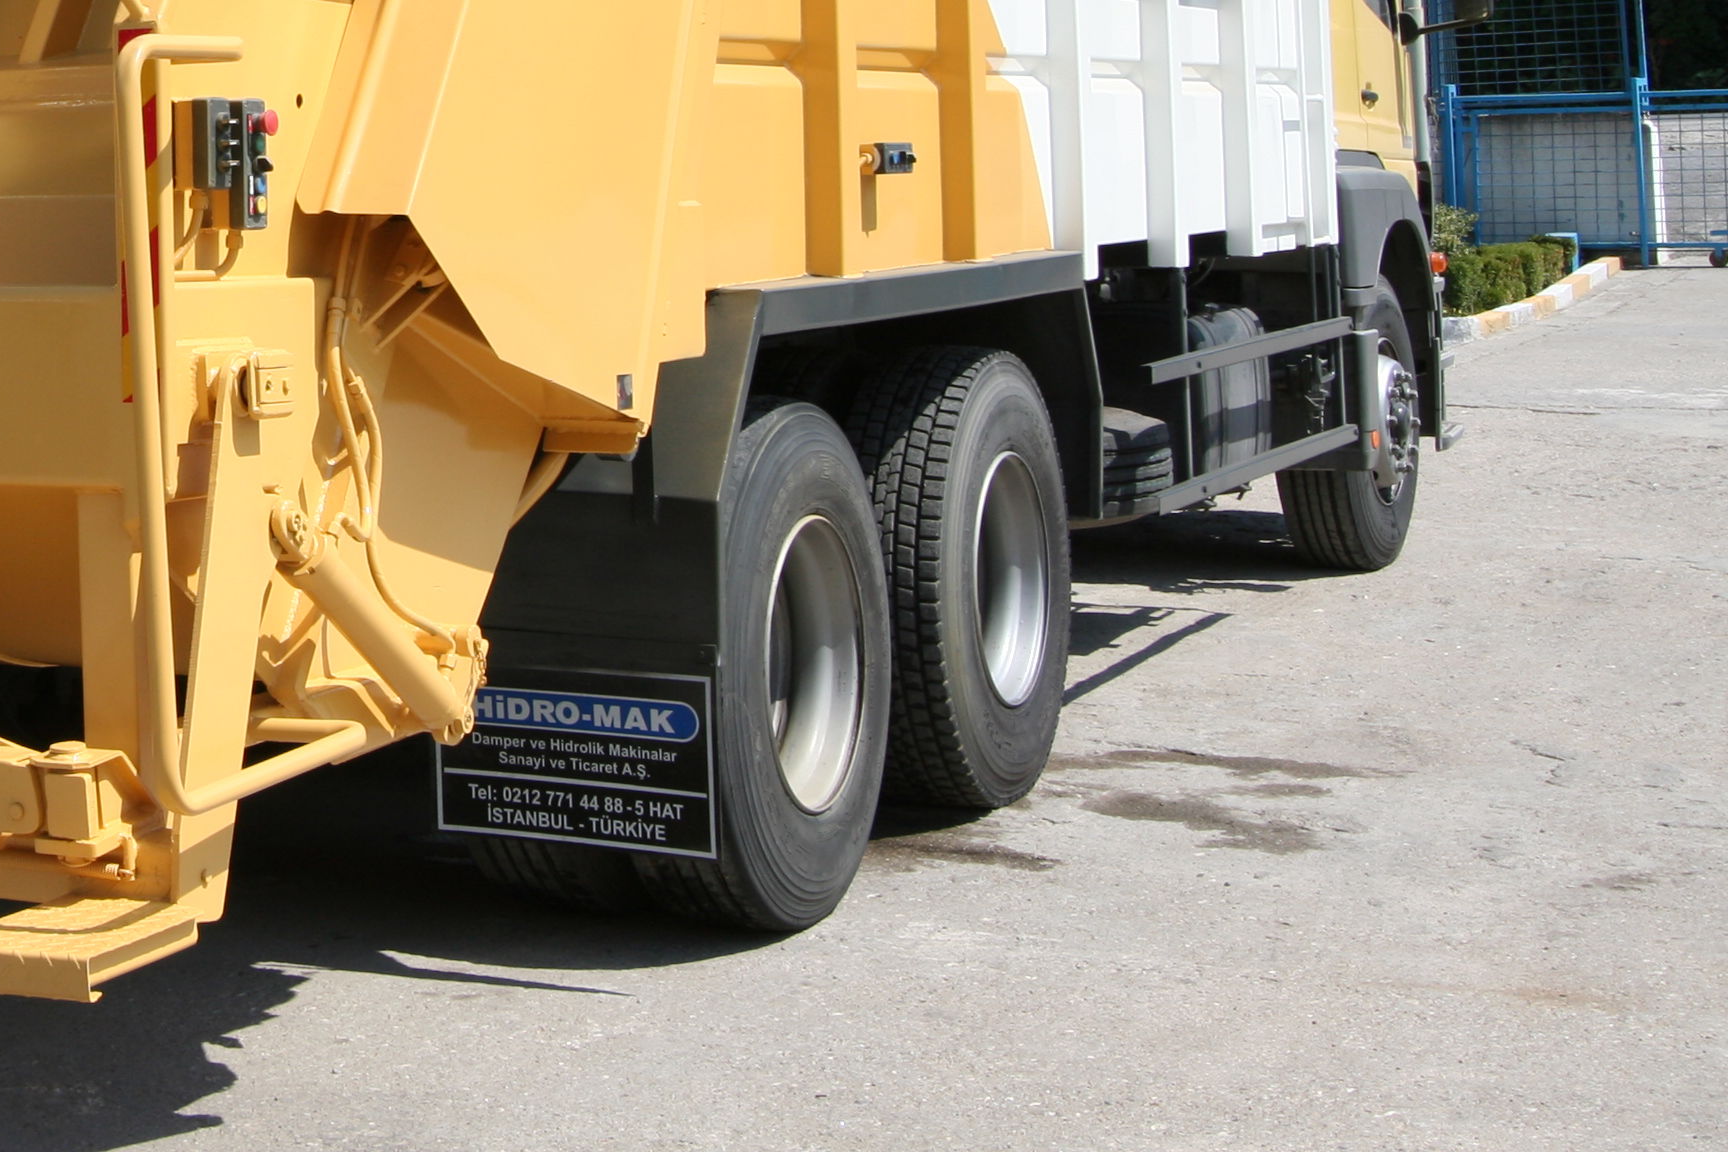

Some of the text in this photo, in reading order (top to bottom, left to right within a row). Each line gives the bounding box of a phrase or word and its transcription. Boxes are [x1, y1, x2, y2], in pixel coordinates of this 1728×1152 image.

[472, 732, 677, 762] Damper ve Hidrolik Makinalar
[498, 751, 651, 780] Sanayi ve Ticaret A.Ş.
[468, 783, 497, 801] Tel:
[502, 786, 541, 805] 0212
[546, 790, 573, 808] 771
[579, 794, 599, 811] 44
[604, 796, 623, 814] 88
[649, 801, 684, 820] HAT
[487, 802, 574, 830] İSTANBUL
[589, 814, 667, 841] TÜRKİYE
